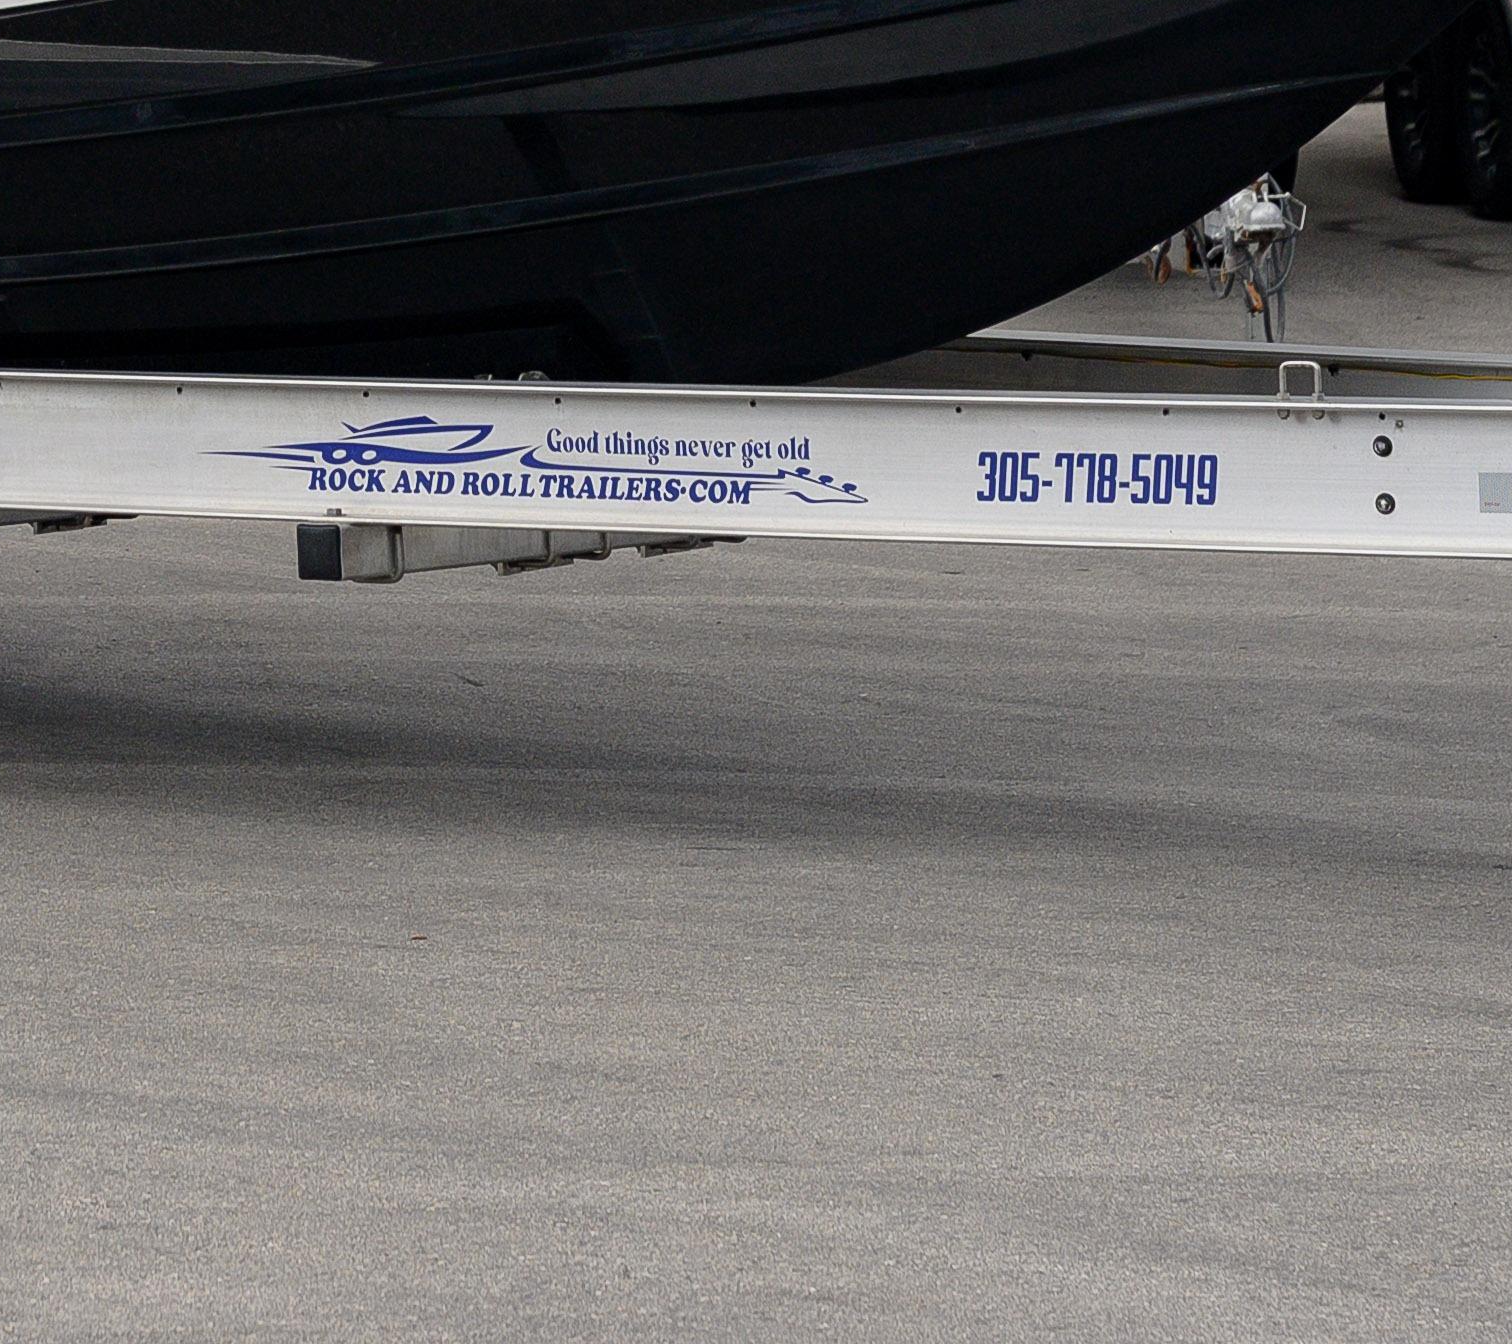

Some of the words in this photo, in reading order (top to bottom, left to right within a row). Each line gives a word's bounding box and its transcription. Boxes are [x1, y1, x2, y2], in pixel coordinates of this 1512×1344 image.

[546, 427, 599, 454] Good
[604, 430, 670, 465] things
[675, 437, 736, 459] never
[741, 438, 772, 468] get
[777, 435, 810, 460] old
[308, 468, 386, 493] ROCK
[391, 470, 455, 495] AND
[460, 472, 536, 498] ROLL
[976, 451, 1219, 506] 305-778-5049
